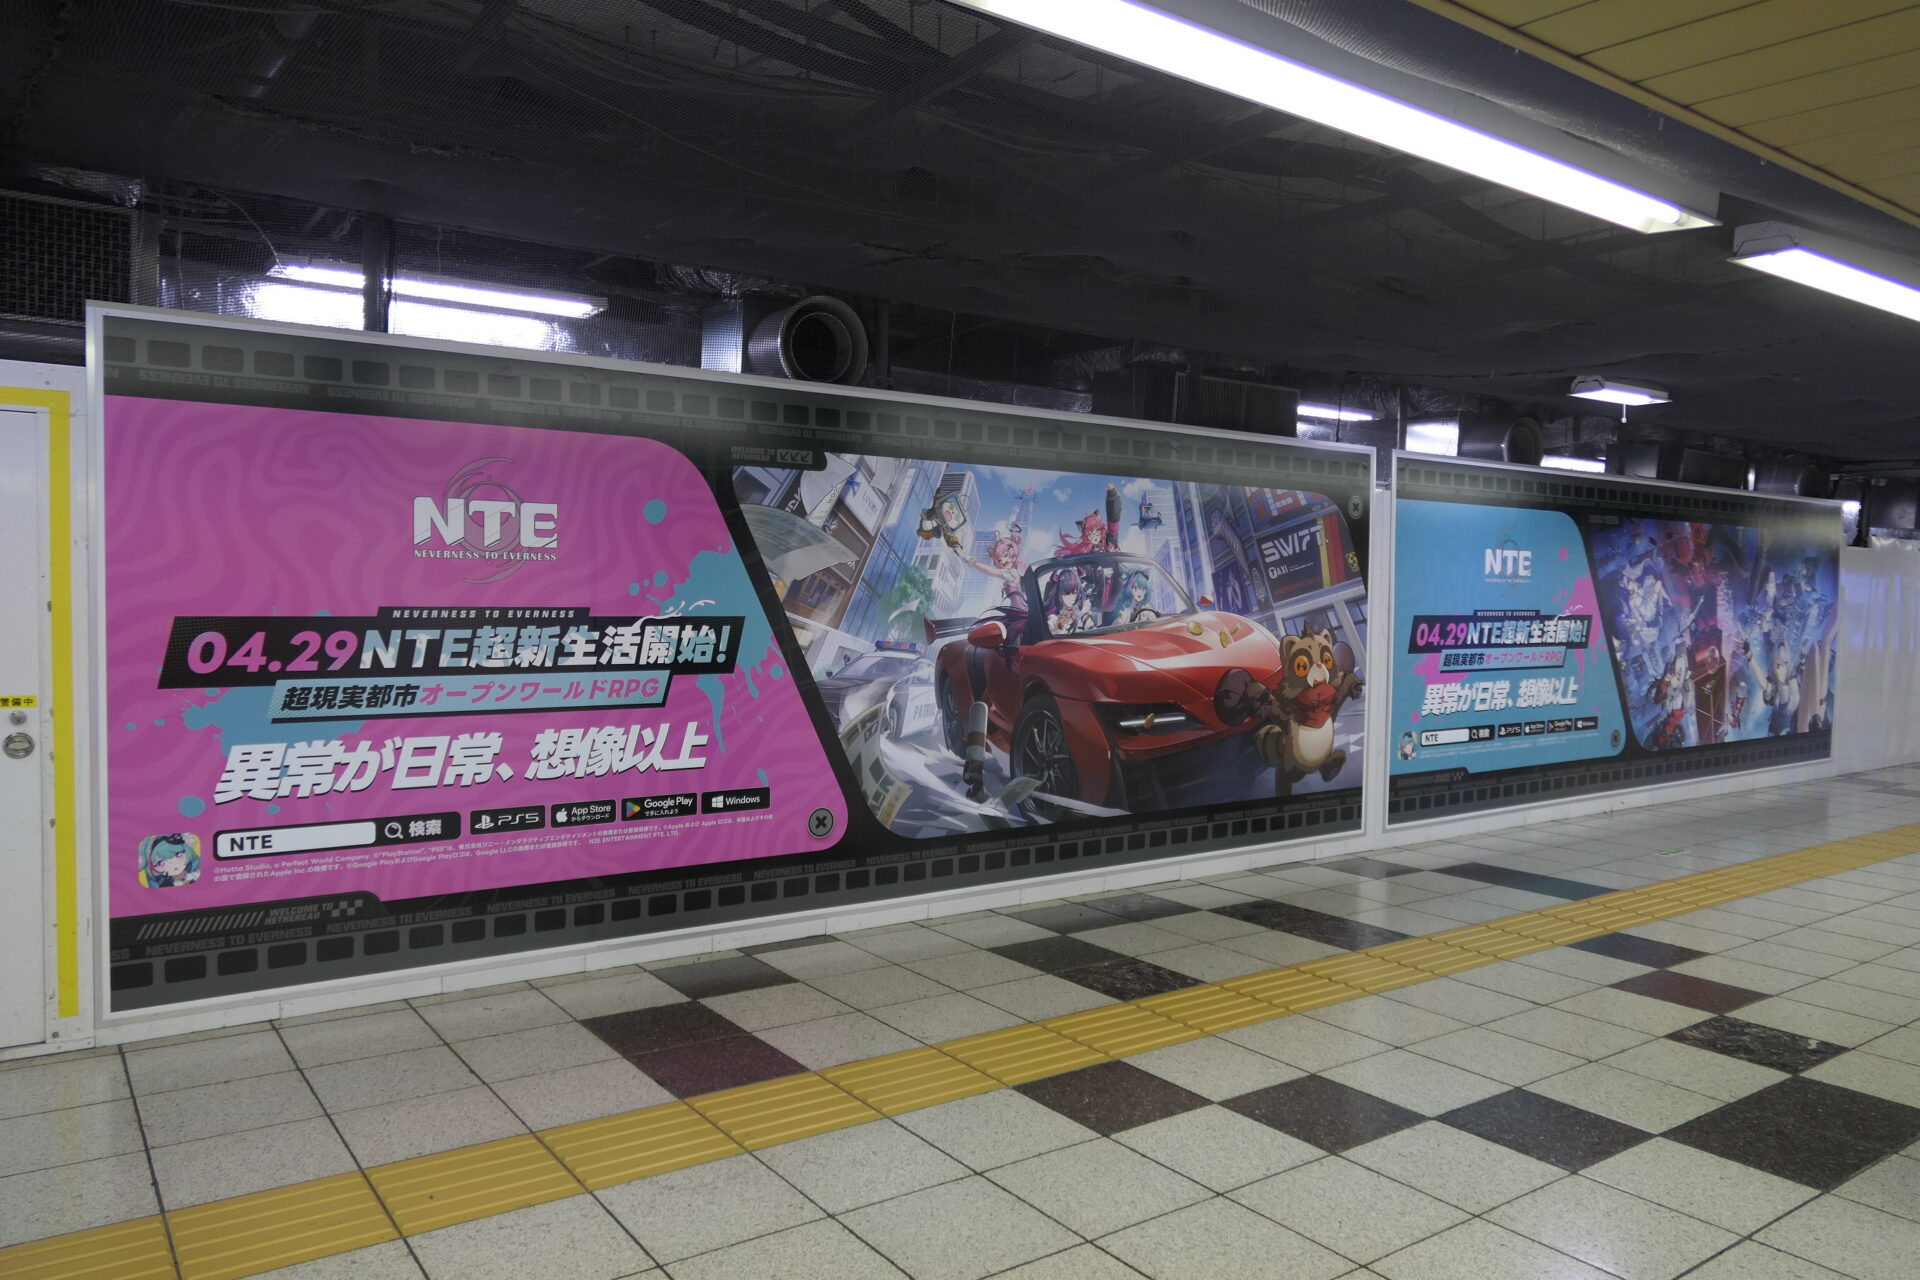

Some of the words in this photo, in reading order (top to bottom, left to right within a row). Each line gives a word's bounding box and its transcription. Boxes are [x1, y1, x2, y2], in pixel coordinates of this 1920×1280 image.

[139, 369, 210, 386] EVERNESS
[213, 376, 228, 388] TO
[233, 378, 309, 394] NEVERNESS
[413, 497, 558, 549] NTE
[414, 549, 479, 560] NEVERNESS
[485, 550, 498, 560] TO
[503, 550, 557, 561] EVERNESS
[1484, 549, 1532, 577] NTE
[392, 610, 476, 619] NEVERNESS
[485, 610, 500, 619] TO
[507, 610, 576, 619] EVERNESS
[281, 678, 660, 711] 超現実都市オープンワールドRPG
[1505, 726, 1521, 734] PS5
[1424, 734, 1439, 743] NTE
[212, 721, 710, 804] 異常が日常、想像以上
[644, 798, 674, 811] Google
[675, 796, 693, 809] Play
[725, 794, 760, 806] Windows
[571, 805, 588, 816] App
[590, 802, 611, 814] Store
[498, 814, 539, 826] PS5
[571, 813, 610, 822] からダウンロード
[409, 819, 442, 838] 検索
[230, 834, 272, 852] NTE
[602, 831, 651, 844] ENTERTAINMENT
[281, 858, 308, 867] Perfect
[310, 855, 333, 865] World
[628, 879, 682, 896] NEVERNESS
[685, 878, 696, 889] TO
[698, 872, 743, 887] EVERNESS
[487, 896, 547, 913] NEVERNESS
[550, 893, 563, 905] TO
[565, 888, 616, 903] EVERNESS
[269, 905, 320, 917] WELCOME
[322, 903, 334, 911] TO
[326, 916, 394, 935] NEVERNESS
[398, 913, 412, 924] TO
[415, 907, 472, 924] EVERNESS
[146, 937, 226, 956] NEVERNESS
[230, 934, 245, 947] TO
[248, 926, 313, 945] EVERNESS
